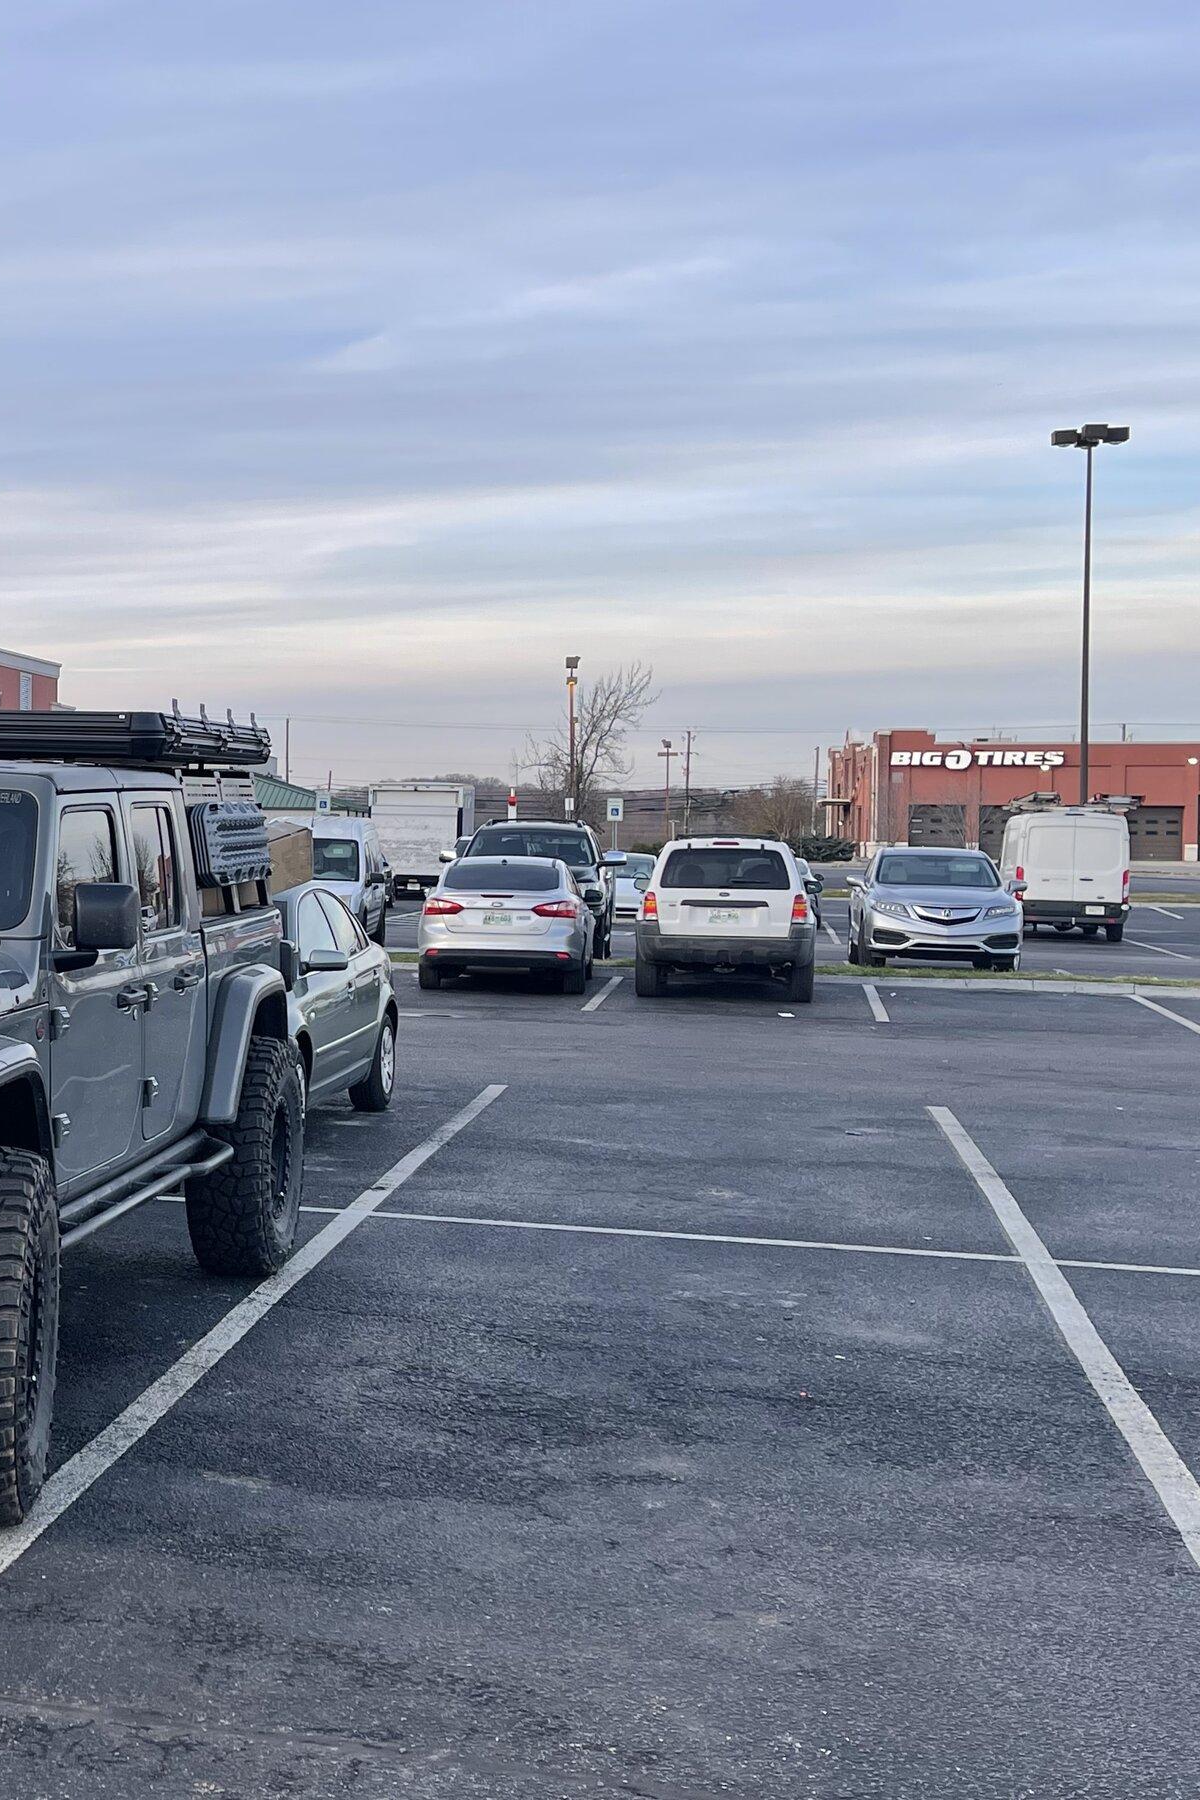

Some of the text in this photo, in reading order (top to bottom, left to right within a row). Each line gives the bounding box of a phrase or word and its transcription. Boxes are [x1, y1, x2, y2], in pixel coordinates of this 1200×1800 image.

[890, 750, 1065, 770] BIG O TIRES
